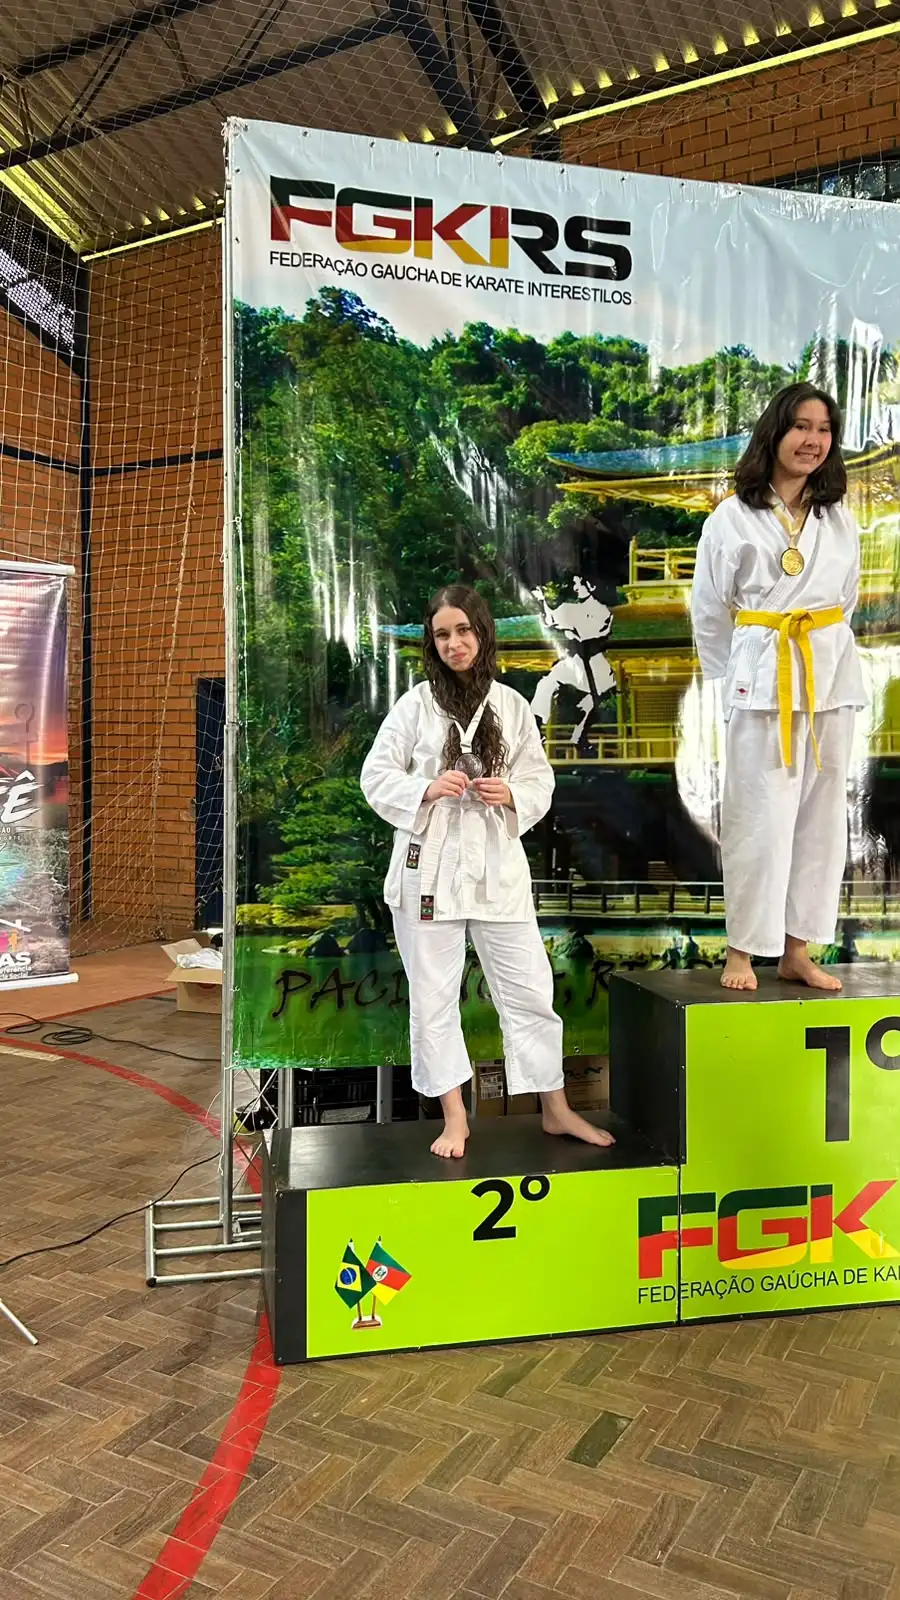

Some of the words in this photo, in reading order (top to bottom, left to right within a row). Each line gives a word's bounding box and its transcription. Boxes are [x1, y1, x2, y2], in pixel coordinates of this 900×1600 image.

[270, 175, 632, 281] FGKIRS
[269, 251, 368, 276] FEDERAÇÃO
[371, 263, 439, 284] GAUCHA
[441, 271, 462, 288] DE
[465, 274, 525, 295] KARATE
[528, 281, 632, 305] INTERESTILOS
[470, 1175, 550, 1241] 2º
[638, 1276, 755, 1304] FEDERAÇÃO
[761, 1269, 838, 1291] GAÚCHA
[843, 1267, 868, 1284] DE
[873, 1264, 900, 1283] KA
